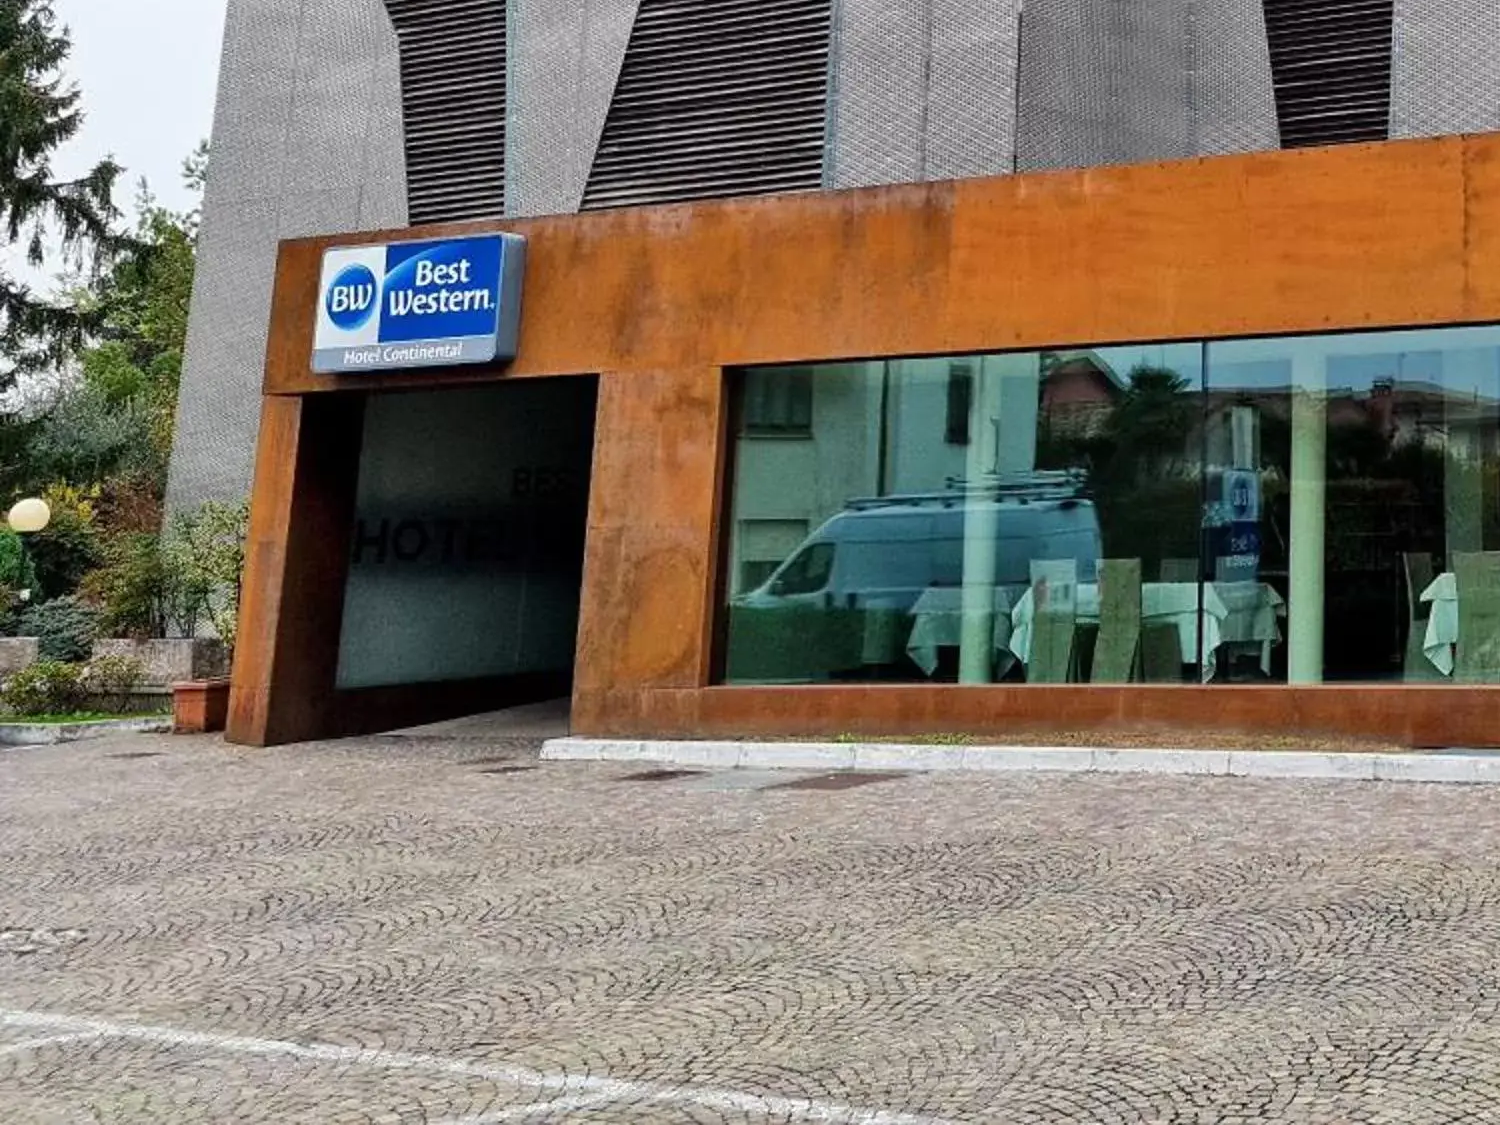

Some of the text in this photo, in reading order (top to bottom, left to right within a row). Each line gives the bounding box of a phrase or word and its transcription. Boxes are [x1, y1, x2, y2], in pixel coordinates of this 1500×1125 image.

[415, 258, 471, 286] Best
[331, 283, 373, 313] BW
[343, 342, 463, 365] Hotel Continental
